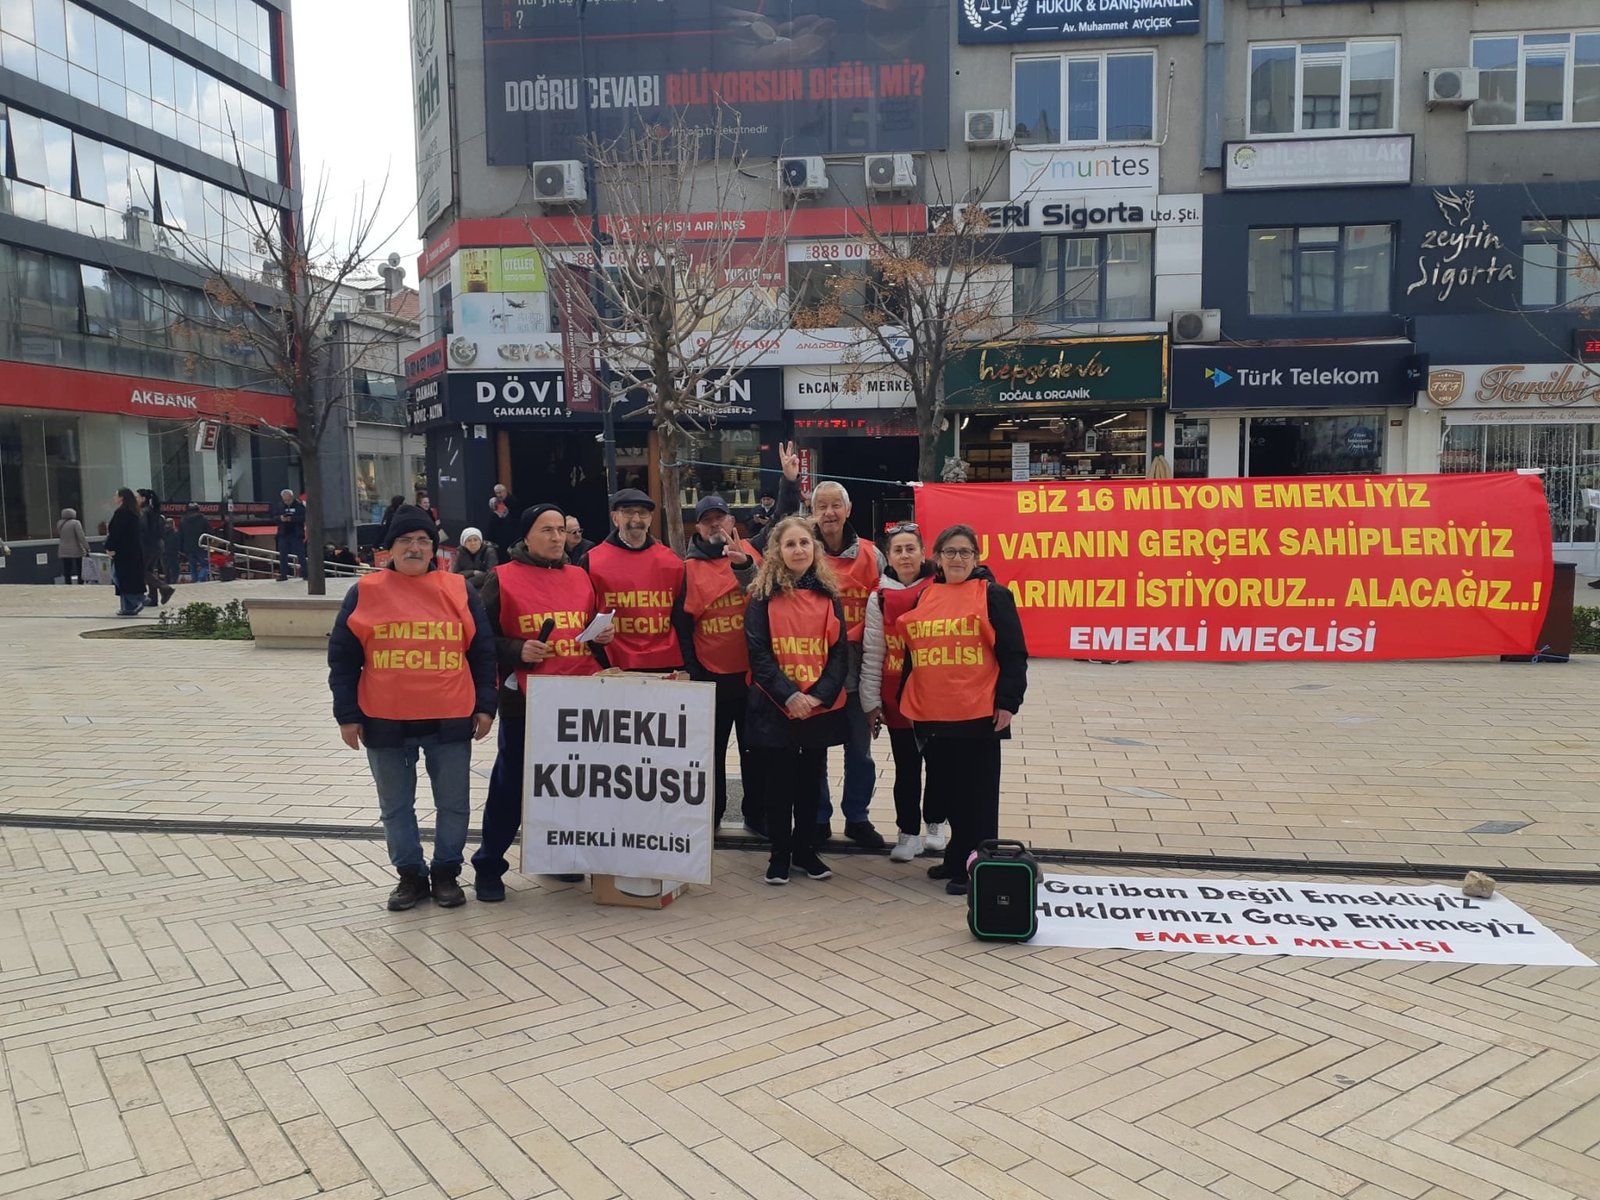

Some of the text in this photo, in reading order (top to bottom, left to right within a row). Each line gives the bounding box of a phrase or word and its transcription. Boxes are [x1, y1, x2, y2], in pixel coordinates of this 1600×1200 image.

[1086, 0, 1097, 12] &
[1063, 17, 1172, 32] Av. Muhammet AYÇİÇEK
[505, 58, 925, 112] DOĞRU CEVABI BİLİYORSUN DEĞİL Mİ?
[1052, 155, 1150, 178] muntes
[1042, 202, 1144, 231] Sigorta
[1150, 208, 1176, 222] Ltd.
[1178, 207, 1200, 223] Şti.
[811, 245, 839, 259] 888
[844, 244, 863, 258] 00
[1407, 256, 1517, 302] Sigorta
[476, 375, 566, 403] DÖVİ
[867, 380, 914, 392] MERKE
[1237, 367, 1380, 386] Türk Telekom
[131, 389, 198, 410] AKBANK
[999, 386, 1091, 402] DOĞAL & ORGANİK
[493, 406, 551, 418] ÇAKMAKÇI
[203, 426, 216, 447] E
[1017, 478, 1431, 514] BİZ 16 MİLYON EMEKLİYİZ
[998, 530, 1129, 560] VATANIN
[1138, 528, 1272, 565] GERÇEK
[1278, 520, 1515, 558] SAHİPLERİYİZ
[1136, 570, 1336, 608] İSTİYORUZ...
[1344, 569, 1543, 611] ALACAĞIZ..!
[906, 615, 981, 640] EMEKLİ
[1069, 619, 1377, 653] EMEKLİ MECLİSİ
[557, 703, 688, 748] EMEKLİ
[533, 753, 707, 806] KÜRSÜSÜ
[546, 827, 691, 854] EMEKLİ MECLİSİ
[1043, 880, 1480, 912] Gariban Değil Emekliyiz
[1036, 901, 1535, 938] Haklarımızı Gasp Ettirmeyiz
